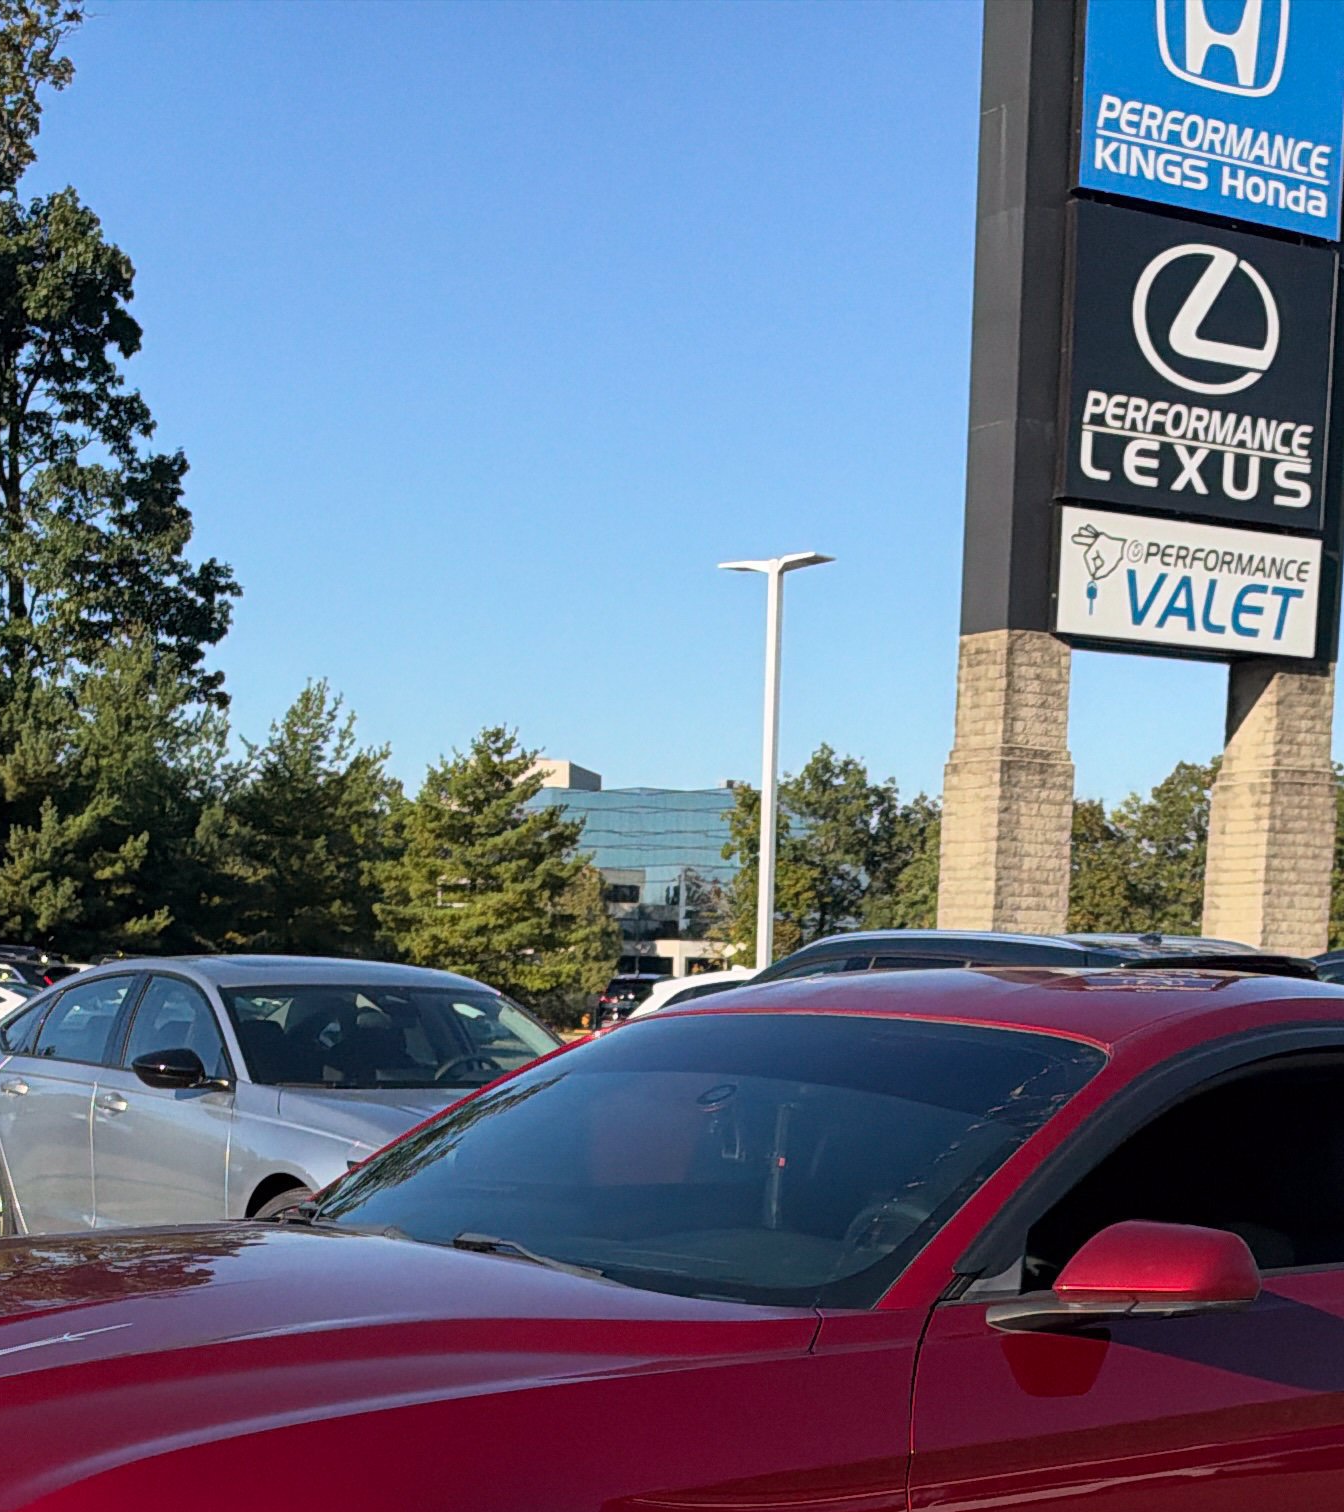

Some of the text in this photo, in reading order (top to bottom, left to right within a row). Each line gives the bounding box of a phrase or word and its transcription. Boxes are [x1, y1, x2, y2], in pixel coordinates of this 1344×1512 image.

[1096, 94, 1332, 178] PERFORMANCE
[1094, 137, 1327, 218] KINGS Honda
[1083, 389, 1314, 457] PERFORMANCE
[1080, 430, 1312, 508] LEXUS
[1144, 541, 1312, 583] PERFORMANCE
[1126, 568, 1304, 641] VALET
